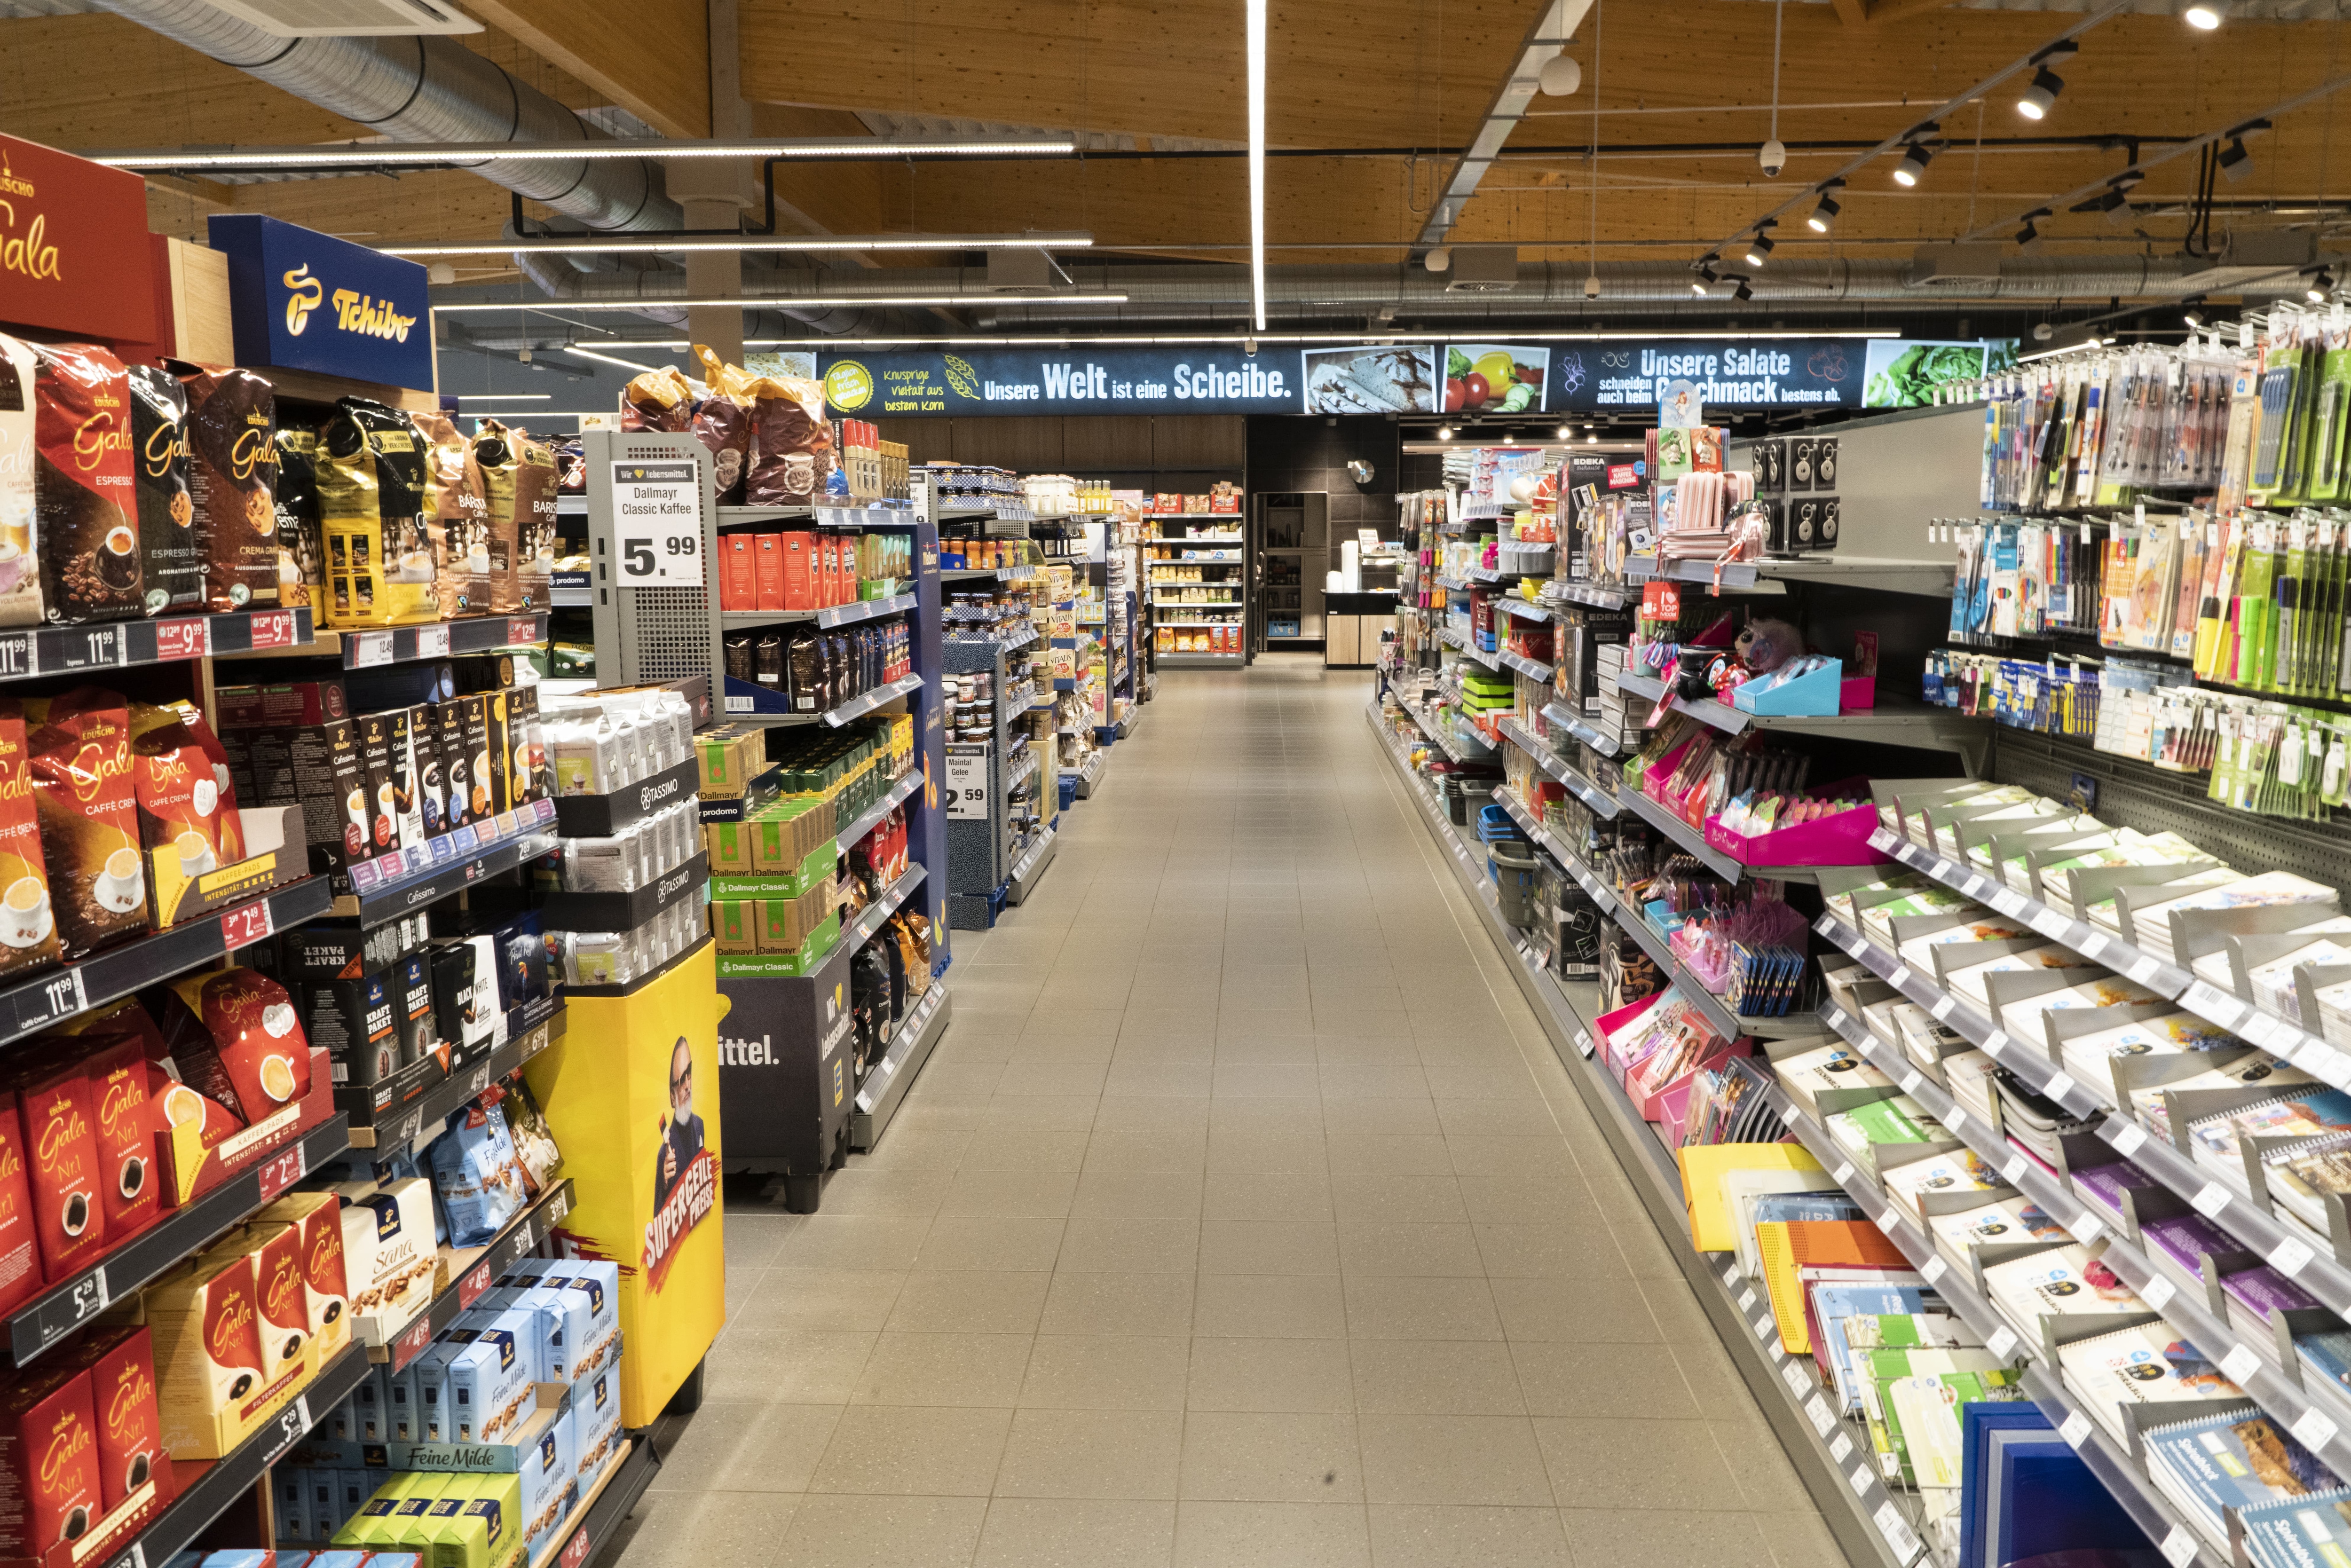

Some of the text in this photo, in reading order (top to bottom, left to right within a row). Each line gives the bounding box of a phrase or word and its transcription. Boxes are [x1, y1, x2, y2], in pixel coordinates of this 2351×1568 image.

[332, 287, 416, 343] Tchibo
[1641, 348, 1791, 376] Unsere Salate
[831, 367, 859, 383] Täglich
[837, 378, 859, 390] frisch
[884, 370, 929, 385] Knusprige
[985, 362, 1292, 401] Unsere Welt ist eine Scheibe.
[1599, 376, 1652, 392] schneiden
[891, 386, 944, 396] Vielfalt aus
[1597, 389, 1652, 403] auch beim
[1655, 376, 1778, 403] Gchmack
[1781, 387, 1822, 402] bestens
[1824, 387, 1841, 402] ab.
[885, 400, 945, 411] bestem Korn
[73, 411, 134, 471] Gala
[96, 475, 133, 486] ESPRESSO
[621, 469, 689, 479] Wir Lebensmittel.
[634, 487, 678, 501] Dallmayr
[622, 503, 692, 515] Classic Kaffee
[151, 548, 189, 559] ESPRESSO
[240, 546, 264, 555] CREMA
[556, 576, 585, 585] prodomo
[1048, 572, 1071, 583] VITALIS
[1051, 613, 1073, 623] VITALIS
[1051, 654, 1072, 664] VITALIS
[468, 725, 485, 734] Cafissimo
[510, 717, 526, 726] Cafissimo
[82, 726, 116, 740] EDUSCHO
[413, 735, 432, 746] Cafissimo
[443, 732, 461, 741] Cafissimo
[333, 753, 355, 765] Cafissimo
[366, 748, 387, 757] Cafissimo
[70, 740, 134, 802] Gala
[149, 748, 190, 793] Gala
[949, 758, 972, 766] Maintal
[649, 778, 678, 802] TASSIMO
[700, 791, 738, 801] Dallmayr
[86, 801, 117, 816] CAFFÈ
[150, 793, 191, 808] CAFFÈ CREMA
[702, 807, 738, 817] prodomo
[17, 821, 39, 837] CREMA
[217, 862, 260, 883] KAFFEE-PADS
[712, 868, 793, 877] Dallmayr Dallmayr
[665, 870, 689, 894] TASSIMO
[728, 883, 789, 892] Dallmayr Classic
[204, 882, 243, 903] INTENSITÄT:
[408, 887, 435, 904] Cafissimo
[163, 882, 186, 925] Vorratspack
[304, 946, 345, 956] PAKET
[759, 946, 797, 955] Dallmayr
[305, 956, 346, 966] KRAFT
[344, 960, 360, 977] NEU
[732, 962, 794, 972] Dallmayr Classic
[406, 984, 427, 1002] KRAFT
[457, 977, 488, 1006] BLACK WHITE
[219, 989, 261, 1024] Gala
[408, 994, 429, 1013] PAKET
[524, 1002, 542, 1020] GUATEMALA
[541, 998, 553, 1010] GRANDE
[827, 995, 836, 1024] Wir
[366, 1004, 390, 1024] KRAFT
[368, 1015, 392, 1035] PAKET
[376, 1087, 392, 1101] KRAFT
[376, 1094, 392, 1108] PAKET
[49, 1099, 72, 1117] EDUSCHO
[100, 1079, 144, 1137] Gala
[117, 1120, 138, 1146] Nr.1
[237, 1115, 285, 1147] KAFFEE-PADS
[39, 1111, 87, 1173] Gala
[118, 1142, 142, 1158] KLASSISCH
[224, 1140, 265, 1168] INTENSITÄT:
[57, 1154, 81, 1182] Nr.1
[180, 1152, 204, 1199] Vorratspack
[59, 1176, 85, 1195] KLASSISCH
[644, 1156, 713, 1270] SUPERGEILE
[689, 1185, 714, 1229] PREISE
[310, 1234, 341, 1285] Gala
[373, 1238, 413, 1275] Sana
[322, 1262, 335, 1280] Nr.1
[267, 1264, 302, 1318] Gala
[281, 1295, 295, 1313] Nr.1
[213, 1300, 252, 1359] Gala
[583, 1323, 597, 1345] Feine
[228, 1332, 244, 1351] Nr.1
[252, 1372, 294, 1409] FILTERKAFFEE
[492, 1363, 527, 1409] Feine Milde
[108, 1374, 151, 1440] Gala
[123, 1416, 145, 1446] Nr.1
[40, 1423, 91, 1494] Gala
[407, 1446, 495, 1467] Feine Milde
[2177, 1437, 2219, 1481] Spiralblock
[57, 1466, 83, 1500] Nr.1
